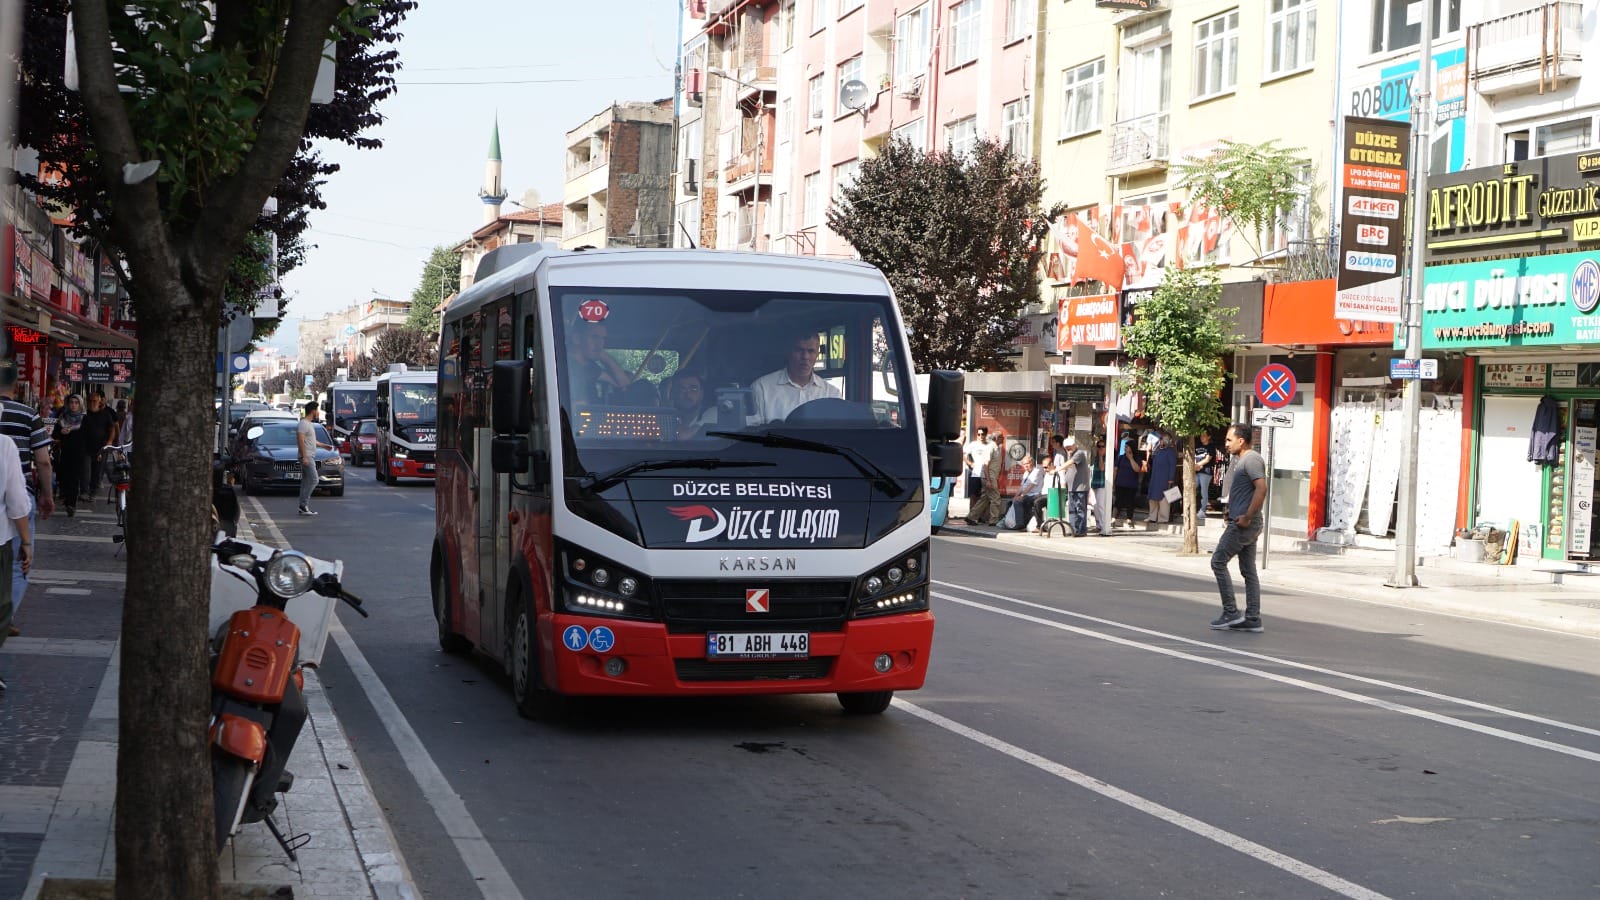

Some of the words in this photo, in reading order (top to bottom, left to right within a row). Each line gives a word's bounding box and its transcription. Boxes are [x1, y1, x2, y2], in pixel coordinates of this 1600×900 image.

[1355, 130, 1398, 149] DÜZCE
[1350, 147, 1402, 166] OTOGAZ
[1350, 177, 1367, 186] TANK
[1428, 163, 1534, 231] AFRODİT
[1538, 183, 1599, 217] GÜZELLİK
[1361, 226, 1385, 240] BRC
[1357, 255, 1394, 269] LOVATO
[1424, 280, 1468, 312] AVCI
[1473, 268, 1568, 309] DÜNYASI
[1574, 264, 1599, 306] MKE
[585, 306, 603, 316] 70
[1339, 301, 1353, 309] YENİ
[1086, 322, 1117, 343] SALONU
[673, 481, 730, 496] DÜZCE
[736, 481, 832, 499] BELEDİYESİ
[680, 505, 774, 543] DÜZCE
[778, 508, 839, 543] ULAŞIM
[719, 556, 796, 571] KARSAN
[718, 635, 734, 652] 81
[745, 635, 771, 652] ABH
[781, 634, 807, 652] 448
